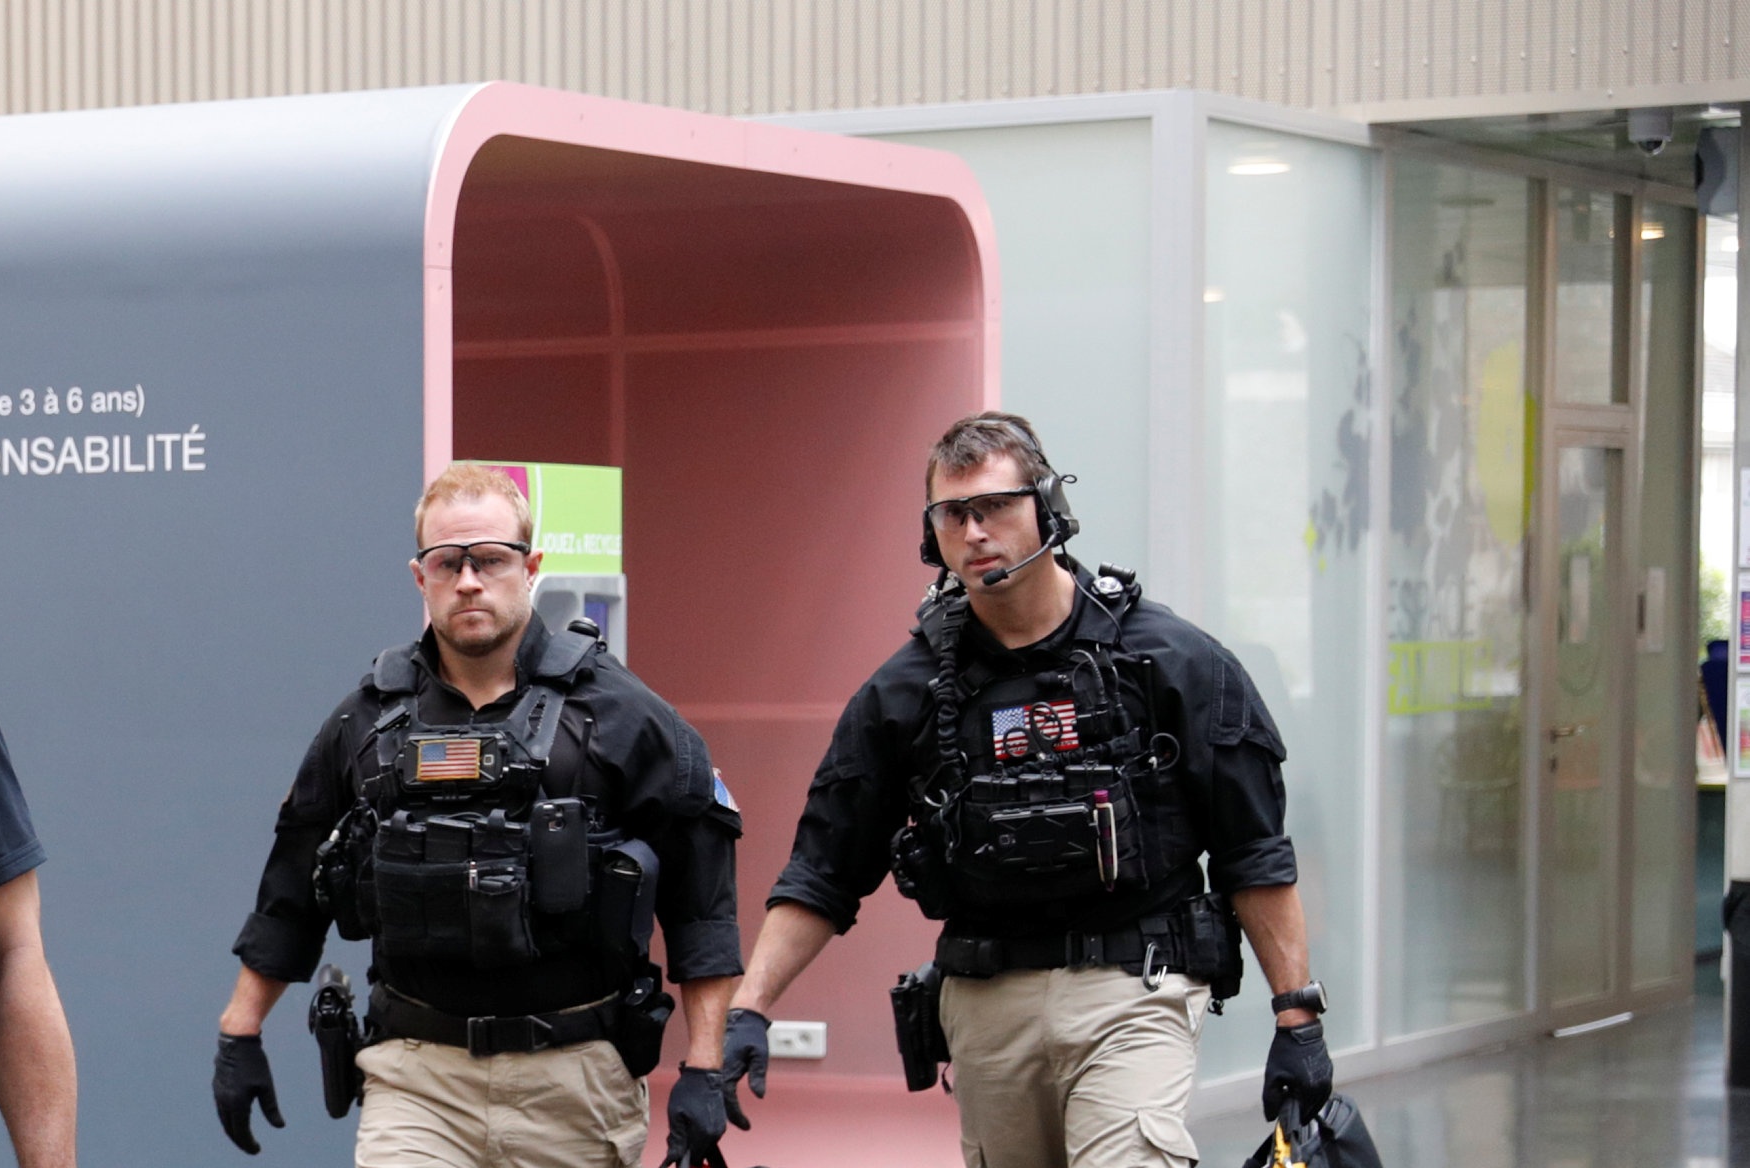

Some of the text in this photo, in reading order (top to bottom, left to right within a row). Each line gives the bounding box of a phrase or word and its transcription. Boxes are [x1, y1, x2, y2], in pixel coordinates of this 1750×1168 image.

[19, 389, 35, 415] 3
[43, 386, 59, 415] à
[67, 387, 83, 414] 6
[91, 384, 145, 416] ans)
